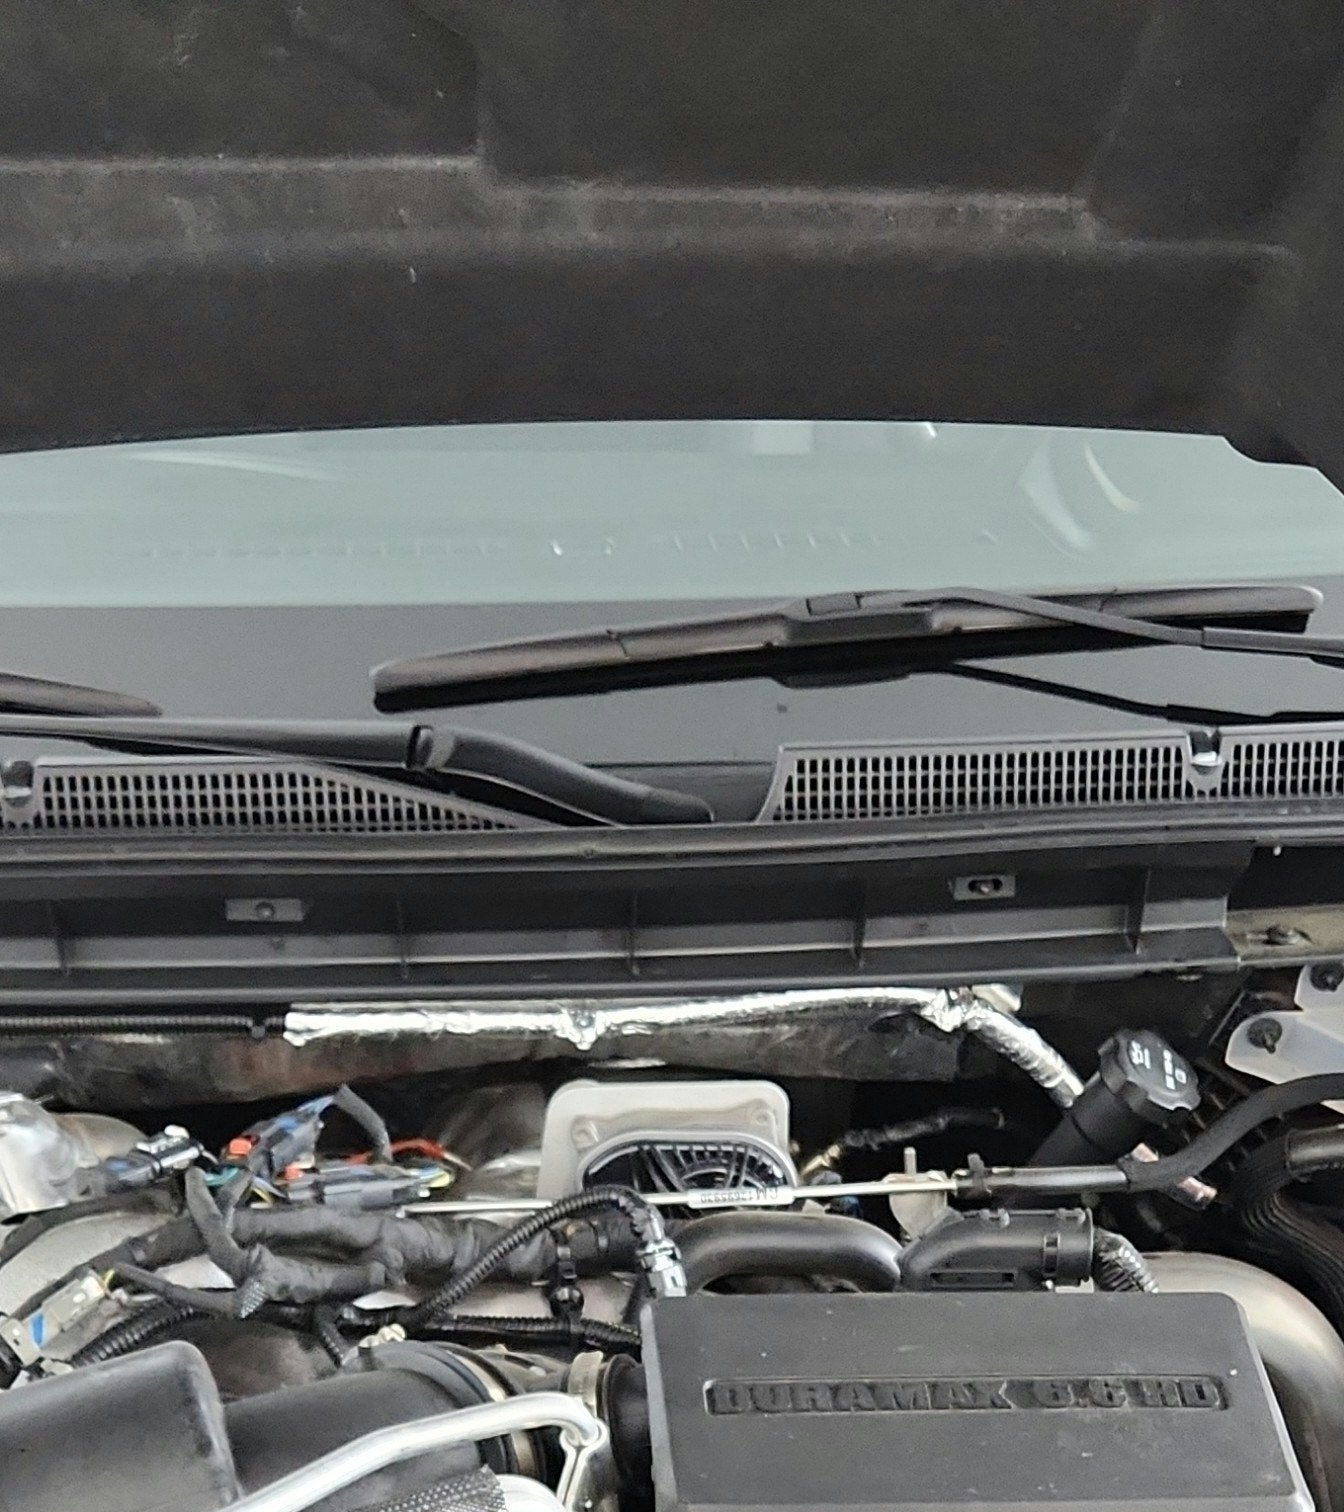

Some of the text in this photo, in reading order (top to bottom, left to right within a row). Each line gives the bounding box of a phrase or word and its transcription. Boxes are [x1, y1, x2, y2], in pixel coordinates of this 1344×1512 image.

[756, 1187, 778, 1200] GM
[713, 1381, 1012, 1415] DURAMAX
[1140, 1378, 1219, 1408] HD
